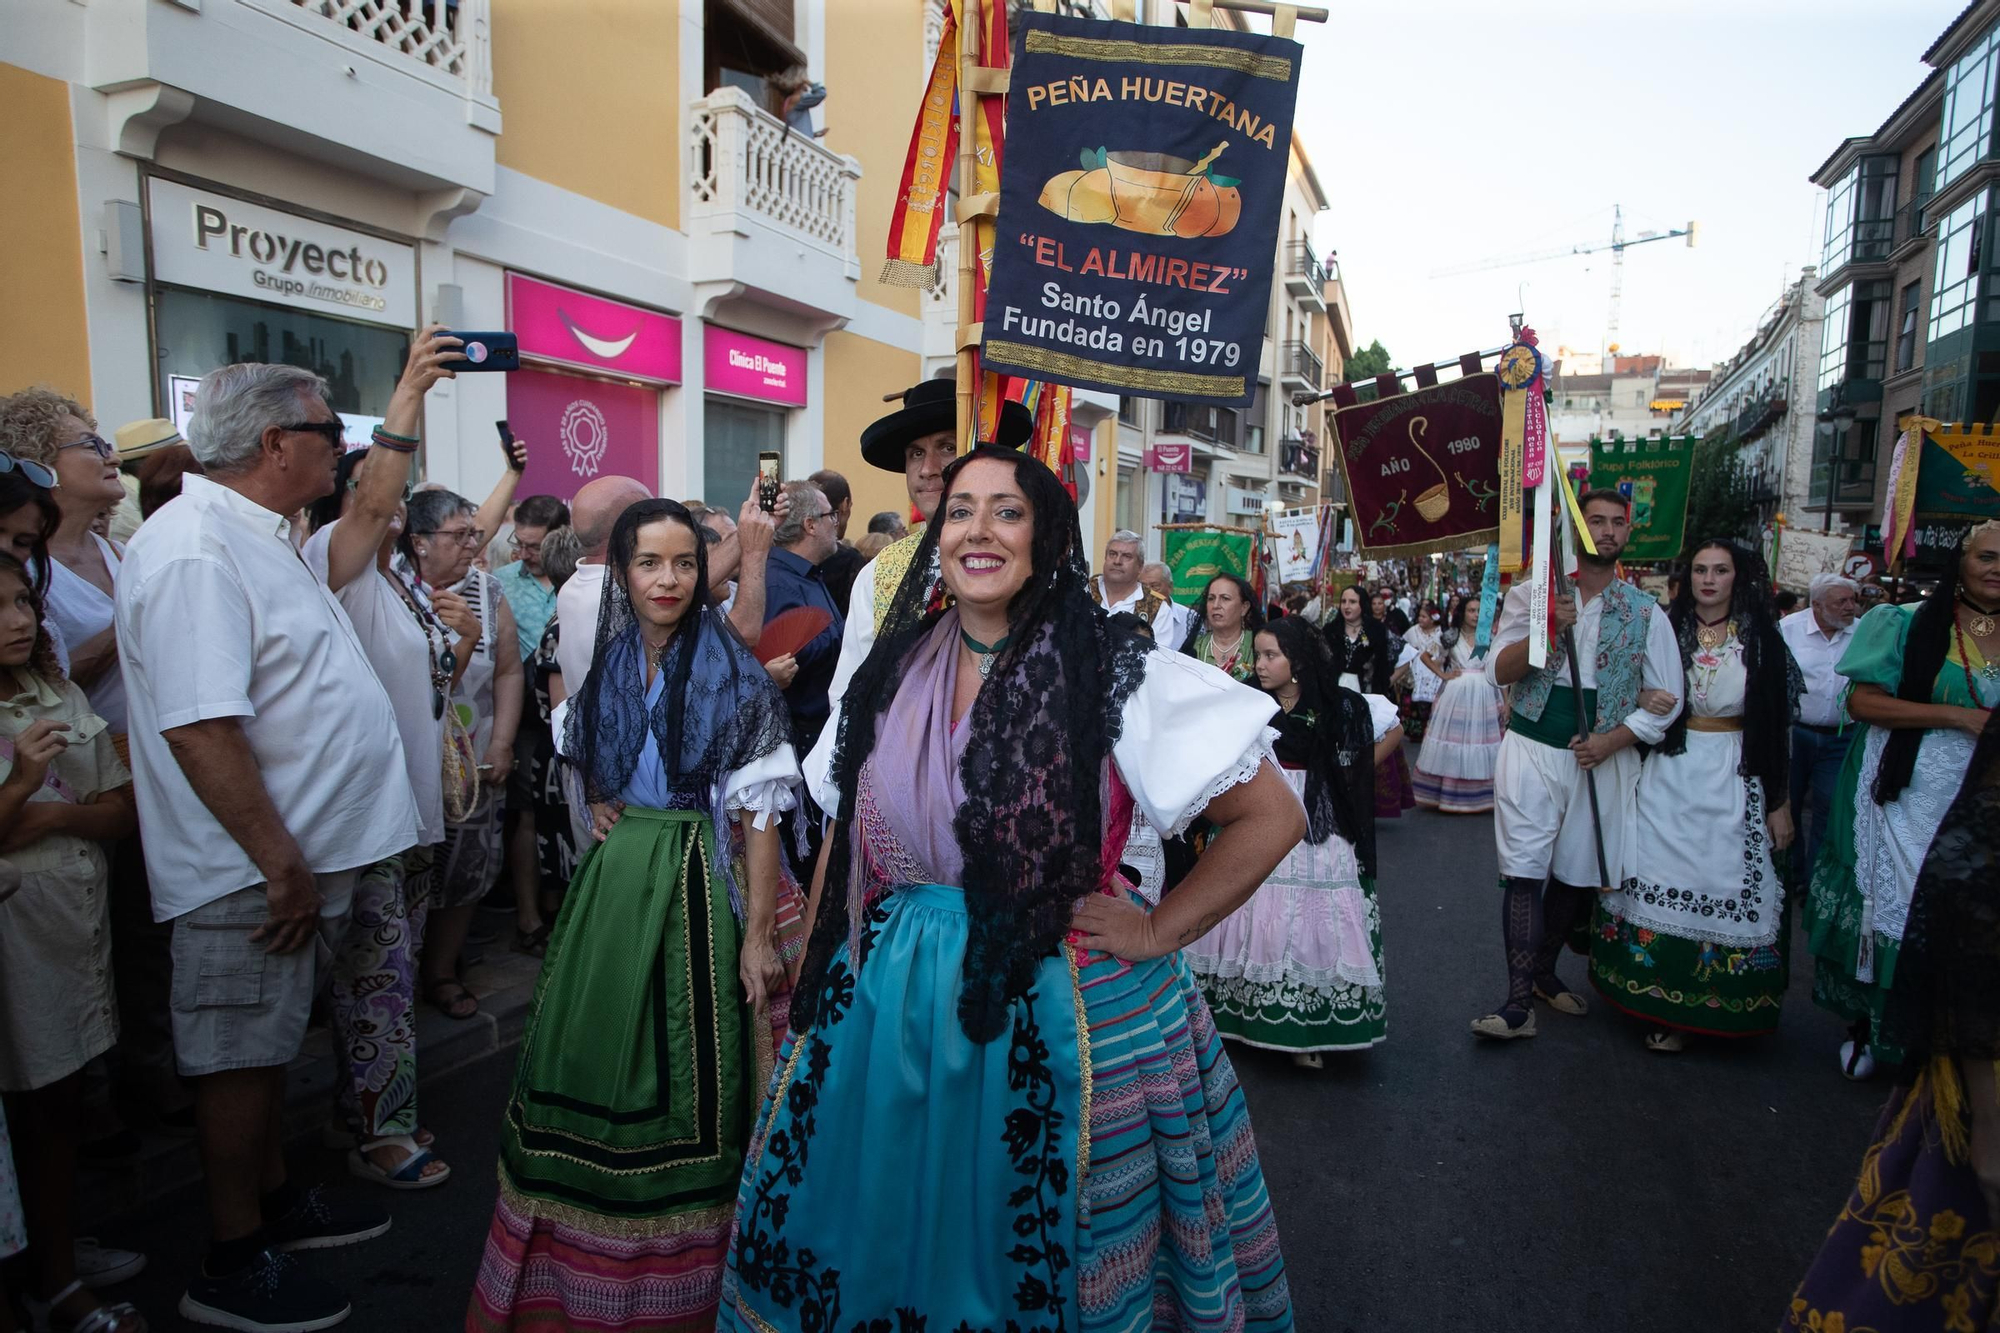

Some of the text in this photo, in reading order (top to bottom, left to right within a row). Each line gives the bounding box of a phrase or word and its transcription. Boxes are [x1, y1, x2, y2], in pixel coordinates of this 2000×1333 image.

[1027, 75, 1276, 150] PEÑA HUERTANA
[192, 203, 388, 289] Proyecto
[1019, 233, 1248, 294] “EL ALMIREZ”
[253, 270, 386, 312] Grupo Inmobiliario
[1041, 281, 1212, 336] Santo Ángel
[1003, 306, 1241, 368] Fundada en 1979
[1381, 435, 1481, 477] AÑO 1980
